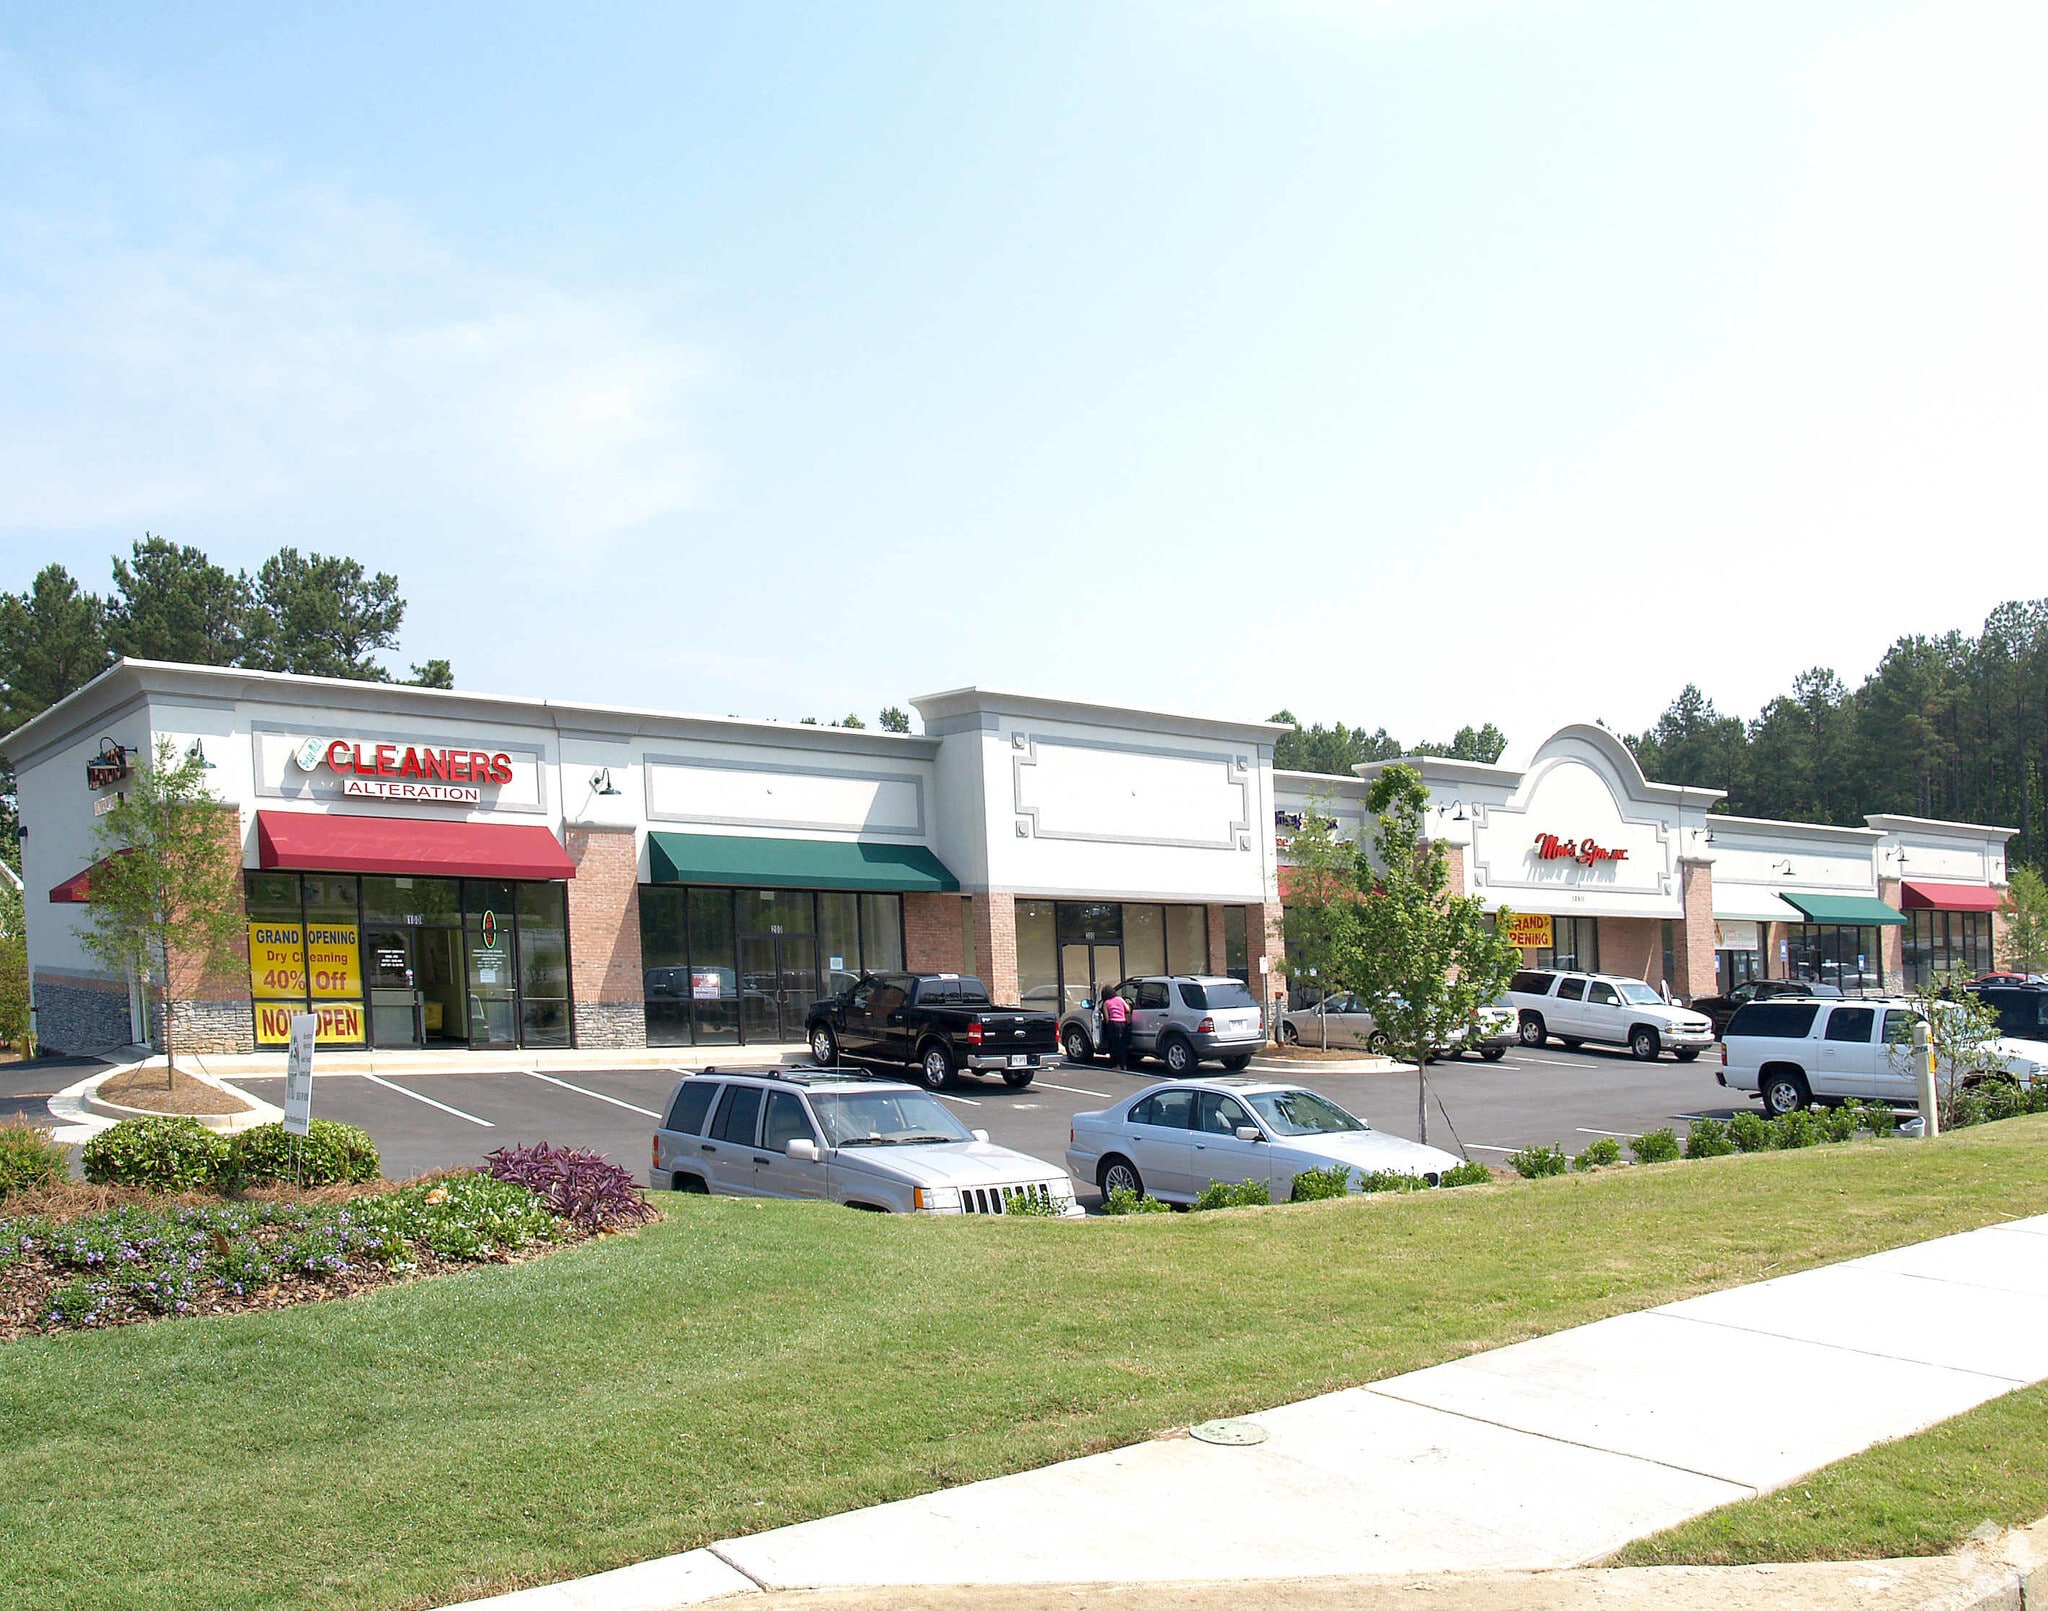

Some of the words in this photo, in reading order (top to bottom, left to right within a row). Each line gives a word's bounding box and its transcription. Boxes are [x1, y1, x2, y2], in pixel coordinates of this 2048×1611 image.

[327, 740, 513, 785] CLEANERS
[349, 781, 478, 801] ALTERATION
[1514, 916, 1544, 931] RAND
[256, 929, 300, 944] GRAND
[308, 930, 356, 945] OPENING
[1509, 932, 1549, 945] PENING
[267, 950, 287, 963] Dry
[292, 951, 348, 966] Cleaning
[263, 969, 306, 991] 40%
[315, 970, 347, 991] Off
[262, 1008, 303, 1037] NO
